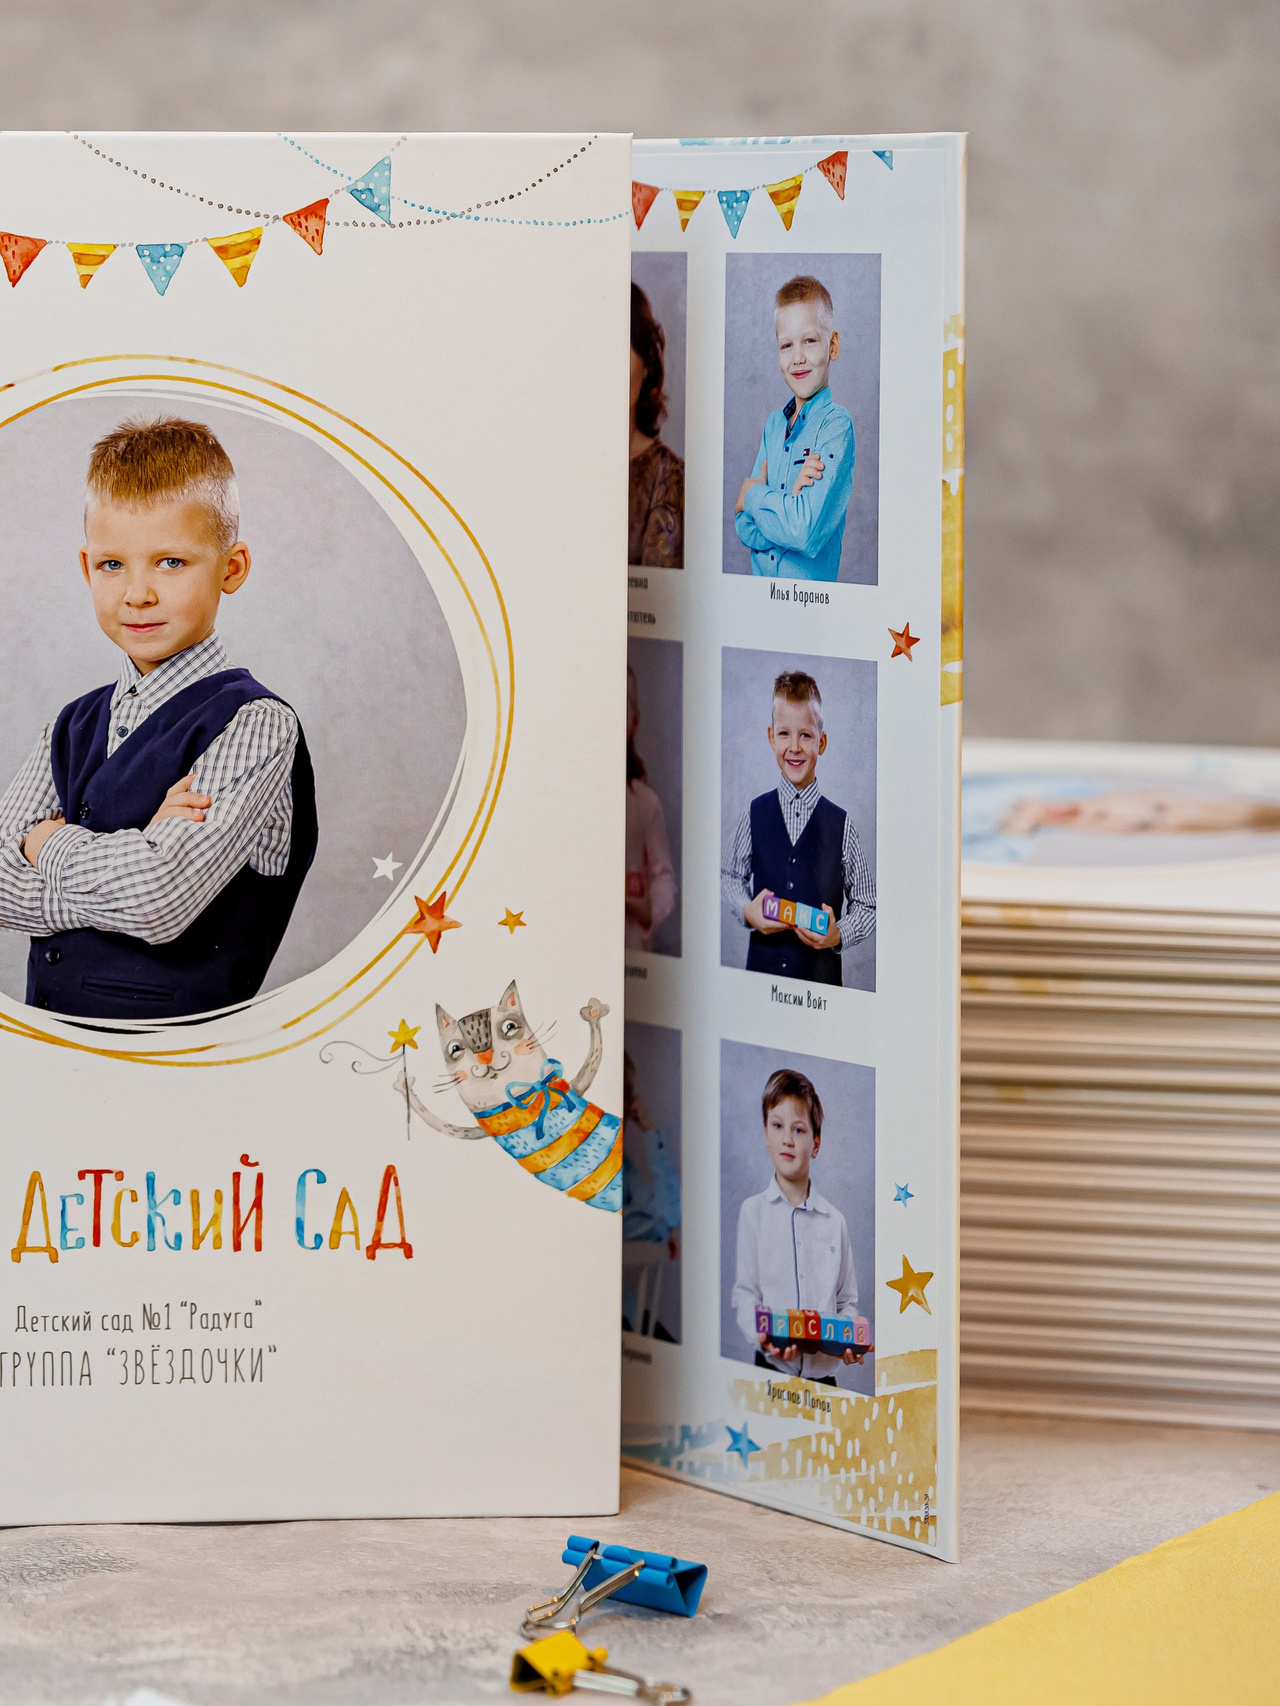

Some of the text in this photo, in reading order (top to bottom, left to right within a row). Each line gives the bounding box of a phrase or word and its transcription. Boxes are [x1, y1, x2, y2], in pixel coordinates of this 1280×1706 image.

[770, 582, 830, 606] Илья Баранов
[771, 984, 828, 1011] Максим Войт
[15, 1305, 92, 1333] Детский
[101, 1310, 134, 1333] сад
[142, 1303, 173, 1332] №1
[0, 1350, 93, 1387] ГРУППА
[766, 1379, 831, 1412] Ярослав Попов
